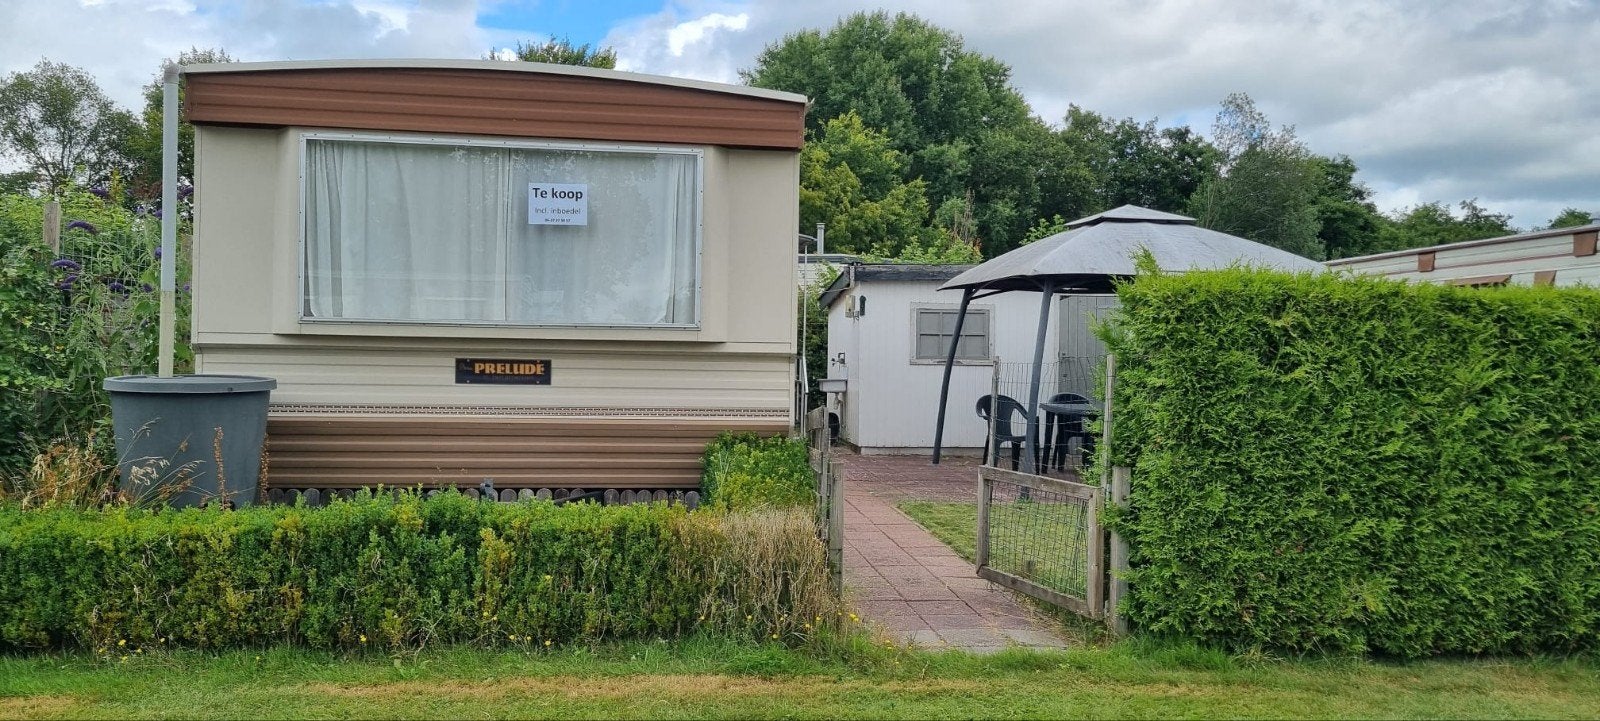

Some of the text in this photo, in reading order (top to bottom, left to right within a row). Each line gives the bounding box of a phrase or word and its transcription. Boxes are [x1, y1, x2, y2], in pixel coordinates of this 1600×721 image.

[532, 187, 584, 202] Te koop
[474, 362, 545, 375] PRELUDE
